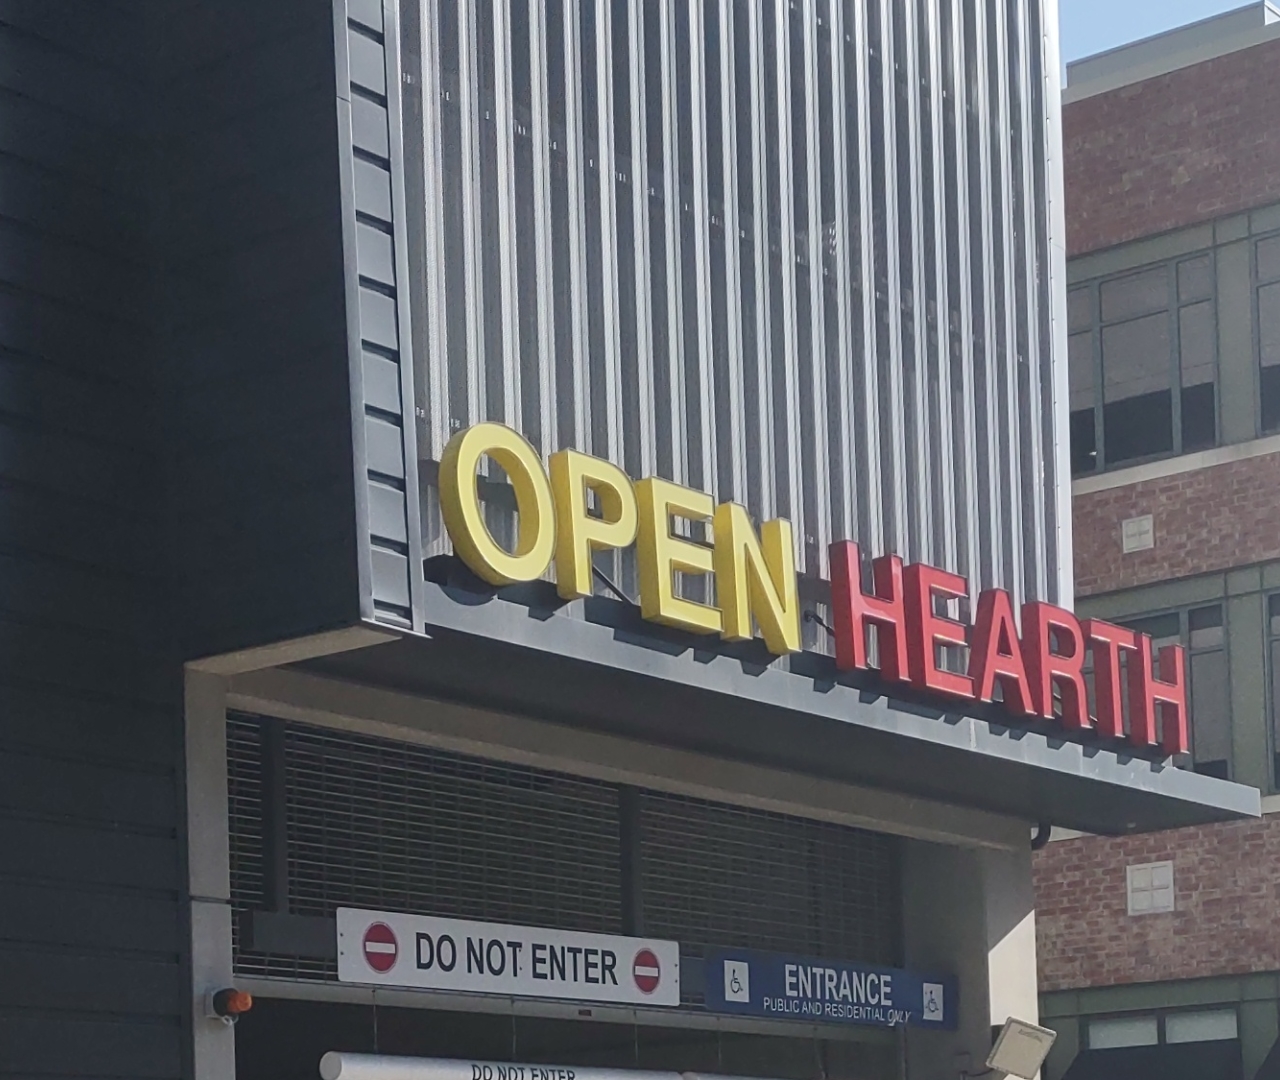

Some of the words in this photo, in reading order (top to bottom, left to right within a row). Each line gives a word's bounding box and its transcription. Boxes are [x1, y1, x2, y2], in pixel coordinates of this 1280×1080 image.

[438, 421, 802, 656] OPEN
[827, 539, 1189, 756] HEARTH
[415, 932, 457, 973] DO
[467, 937, 522, 978] NOT
[531, 943, 619, 986] ENTER
[785, 963, 893, 1006] ENTRANCE
[763, 996, 800, 1014] PUBLIC
[802, 1001, 822, 1015] AND
[824, 1002, 885, 1021] RESIDENTIAL
[887, 1008, 912, 1026] ONLY
